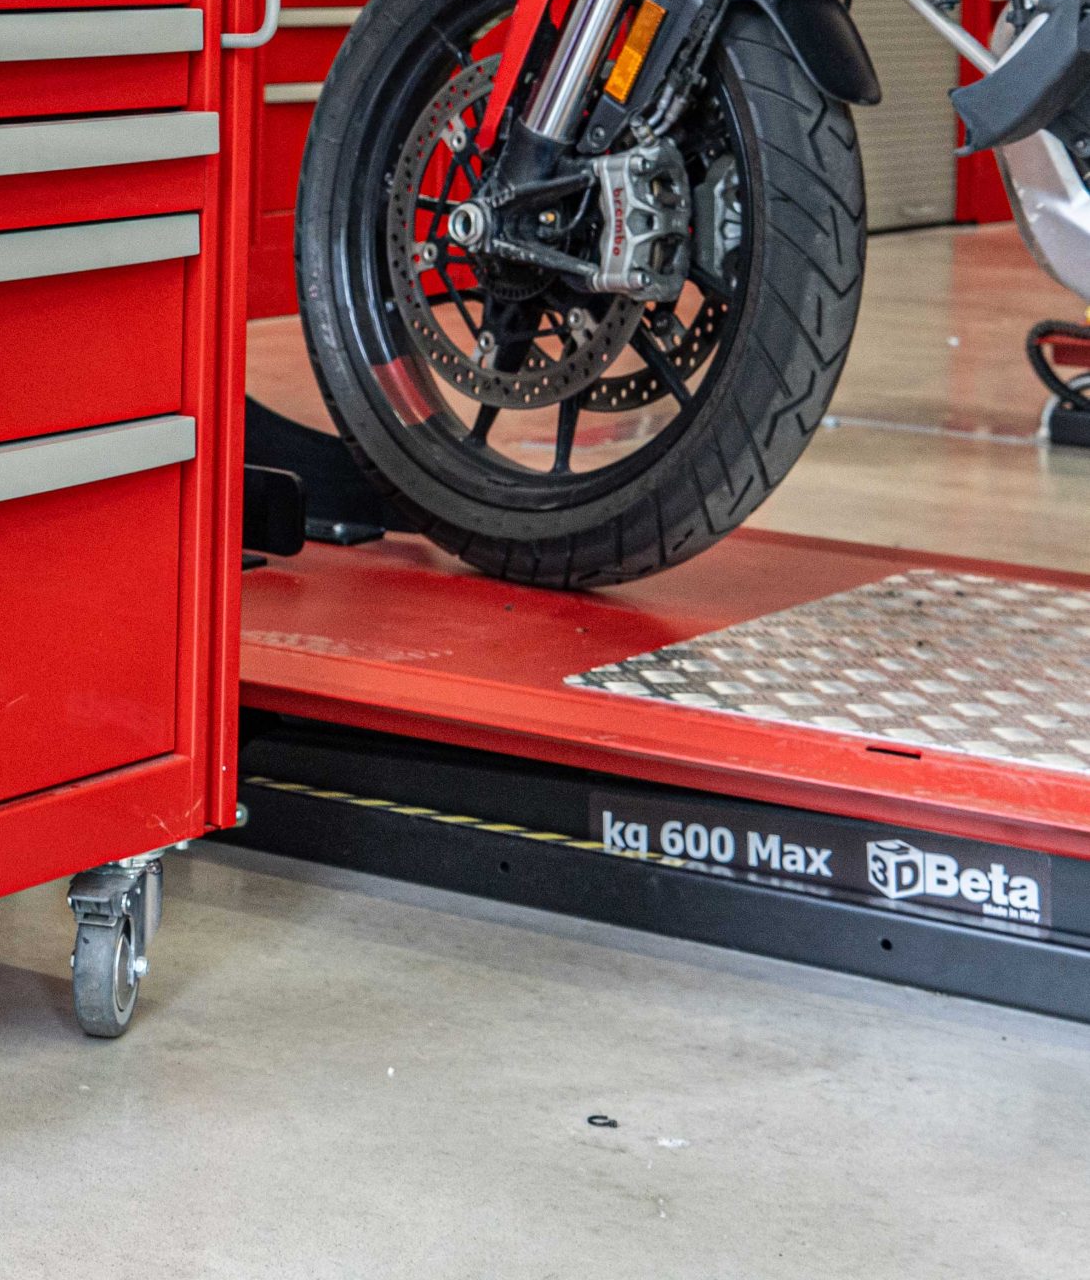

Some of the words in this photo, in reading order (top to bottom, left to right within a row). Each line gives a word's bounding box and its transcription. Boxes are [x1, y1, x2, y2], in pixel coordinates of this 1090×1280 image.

[613, 188, 623, 257] brembo
[660, 820, 736, 864] 600
[747, 830, 833, 878] Max
[925, 852, 1040, 911] Beta
